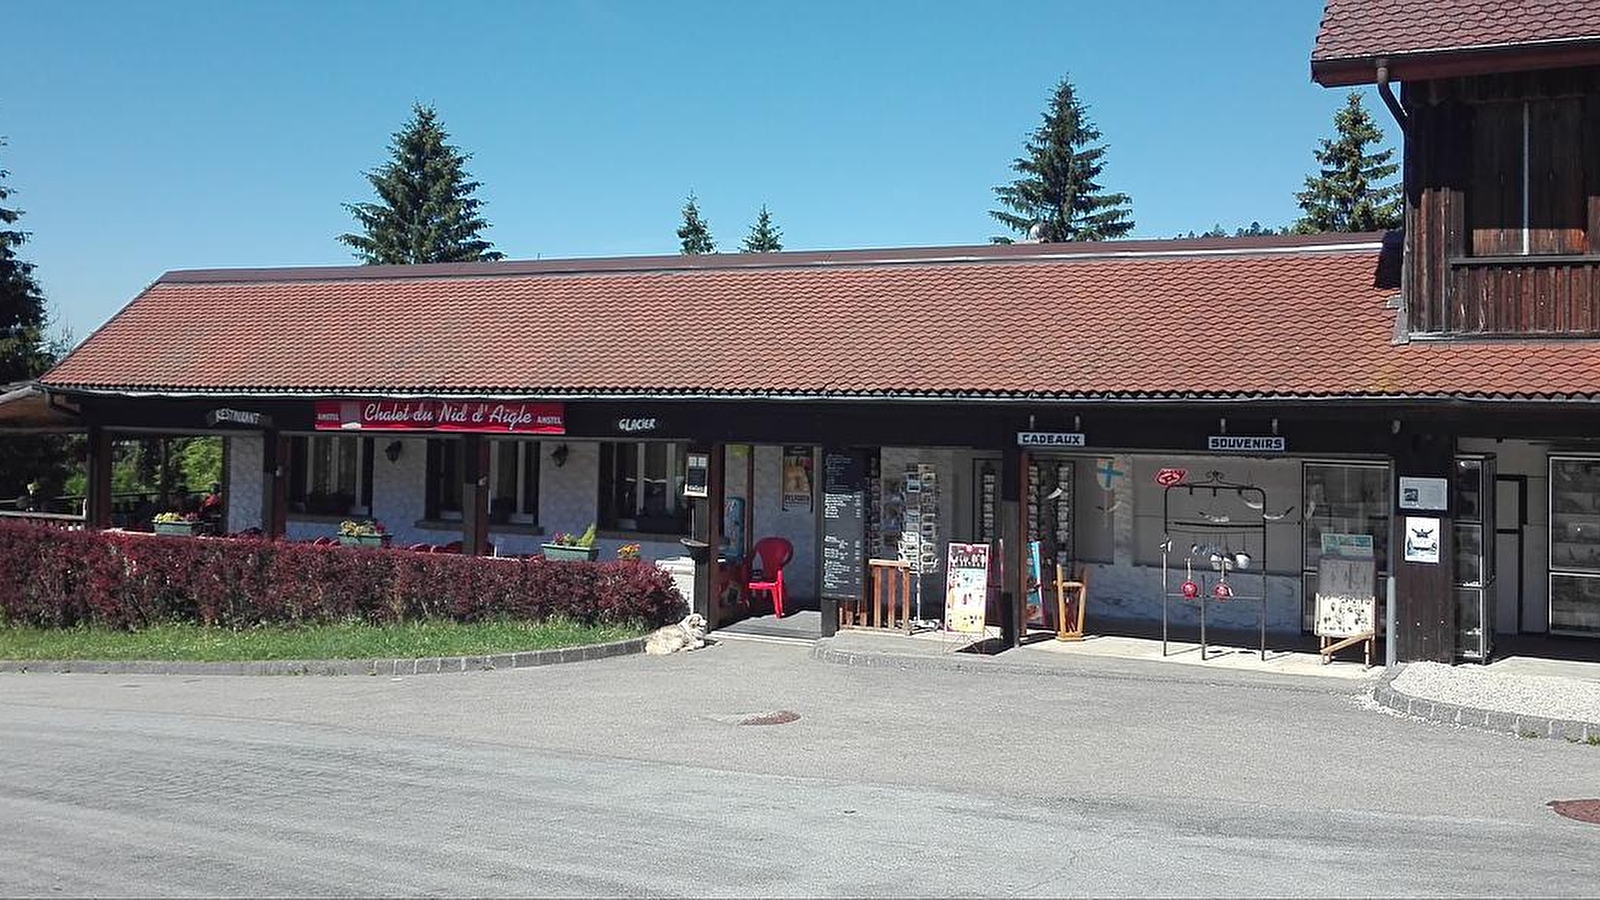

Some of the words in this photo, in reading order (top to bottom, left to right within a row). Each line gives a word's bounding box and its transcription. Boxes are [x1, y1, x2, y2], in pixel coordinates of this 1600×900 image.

[364, 402, 409, 422] Chalet
[413, 405, 433, 422] du
[438, 402, 467, 423] Nid
[472, 404, 532, 430] d'Aigle
[537, 415, 563, 424] AMSTEL
[618, 418, 656, 431] GLACIER
[1022, 433, 1081, 445] CADEAUX
[1211, 438, 1283, 449] SOUVENIRS
